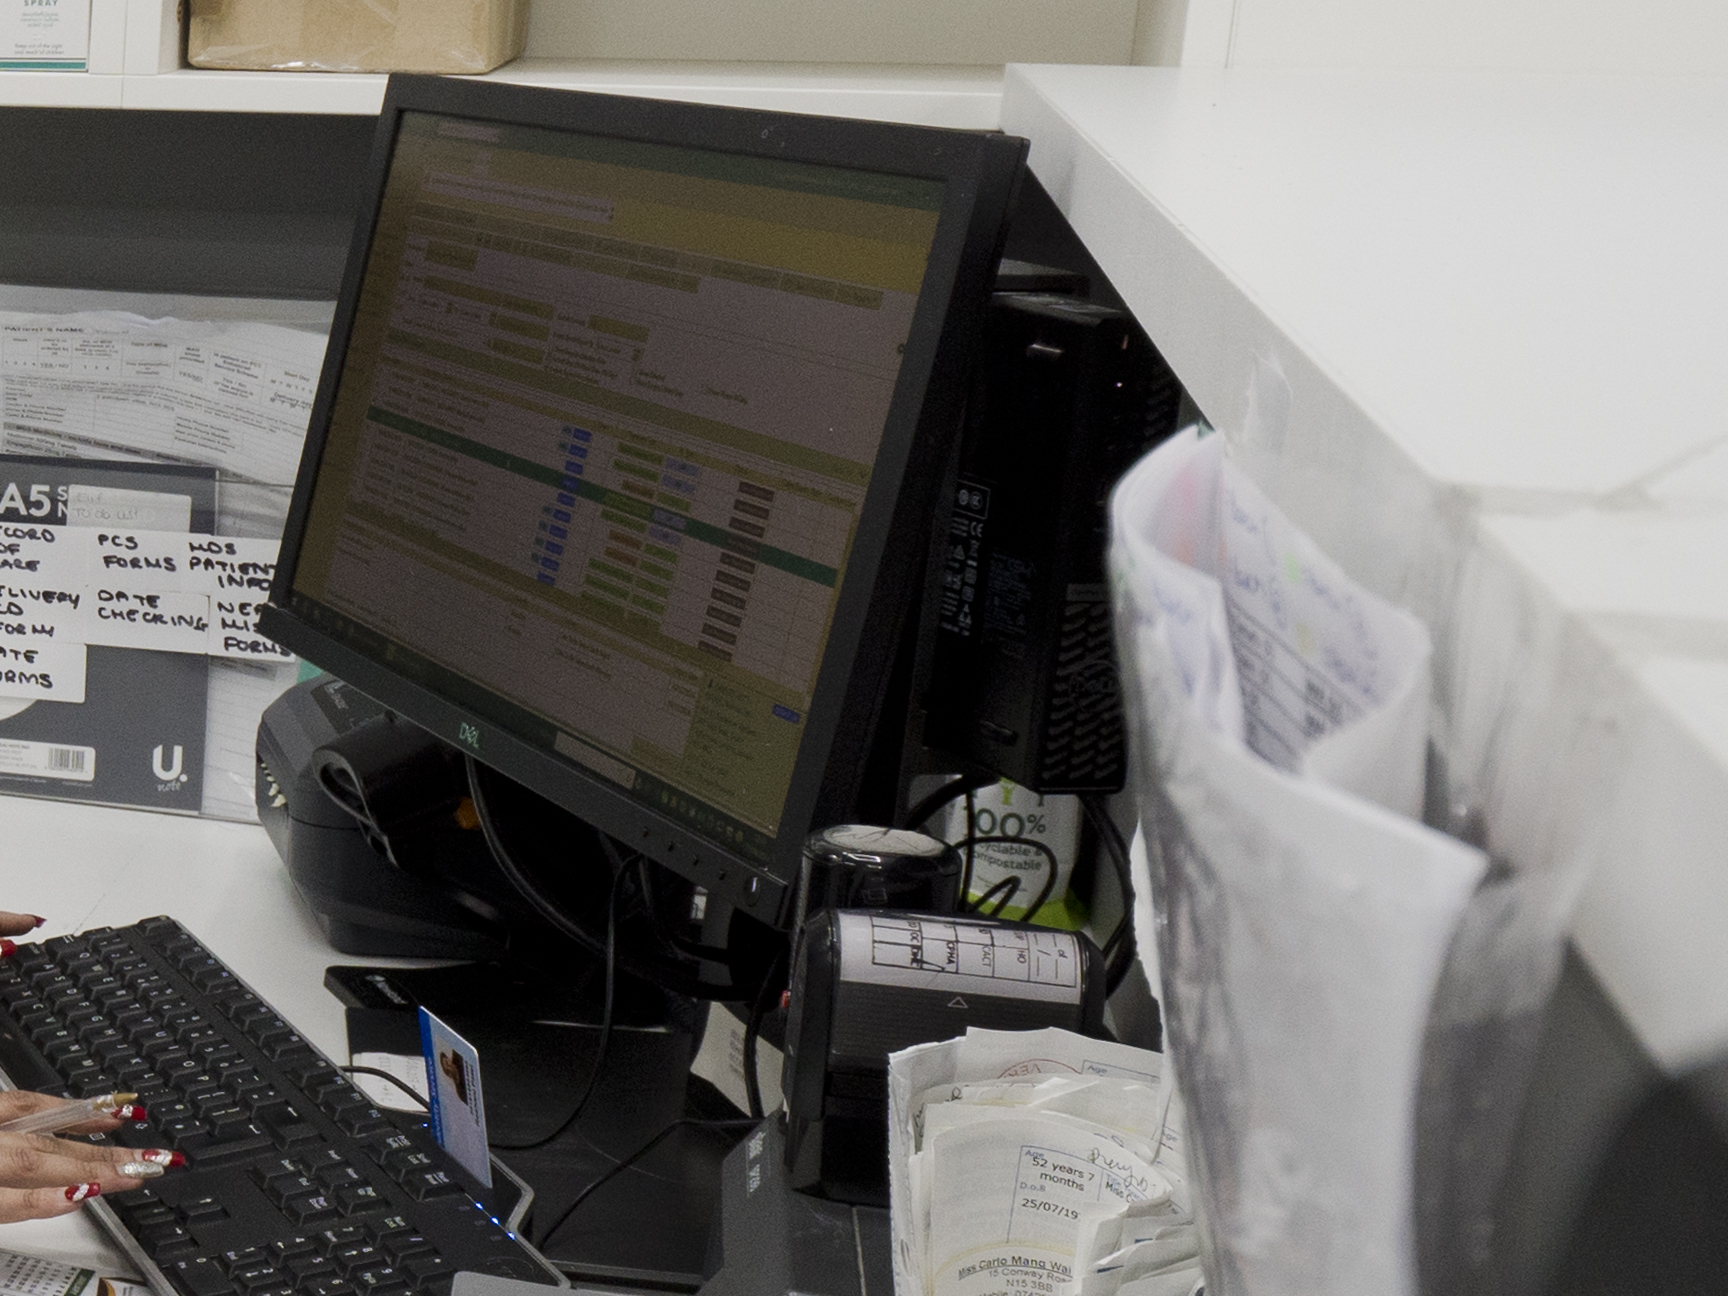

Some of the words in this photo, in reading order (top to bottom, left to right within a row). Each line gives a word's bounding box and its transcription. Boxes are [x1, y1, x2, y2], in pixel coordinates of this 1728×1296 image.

[23, 0, 59, 7] SPRAY
[98, 534, 139, 551] PCS
[103, 555, 177, 573] FORMS
[217, 575, 271, 592] INFO
[98, 590, 161, 608] DATE
[98, 607, 210, 633] CHECKING
[459, 722, 479, 749] DELL
[1051, 1162, 1086, 1180] years
[1039, 1170, 1086, 1192] months
